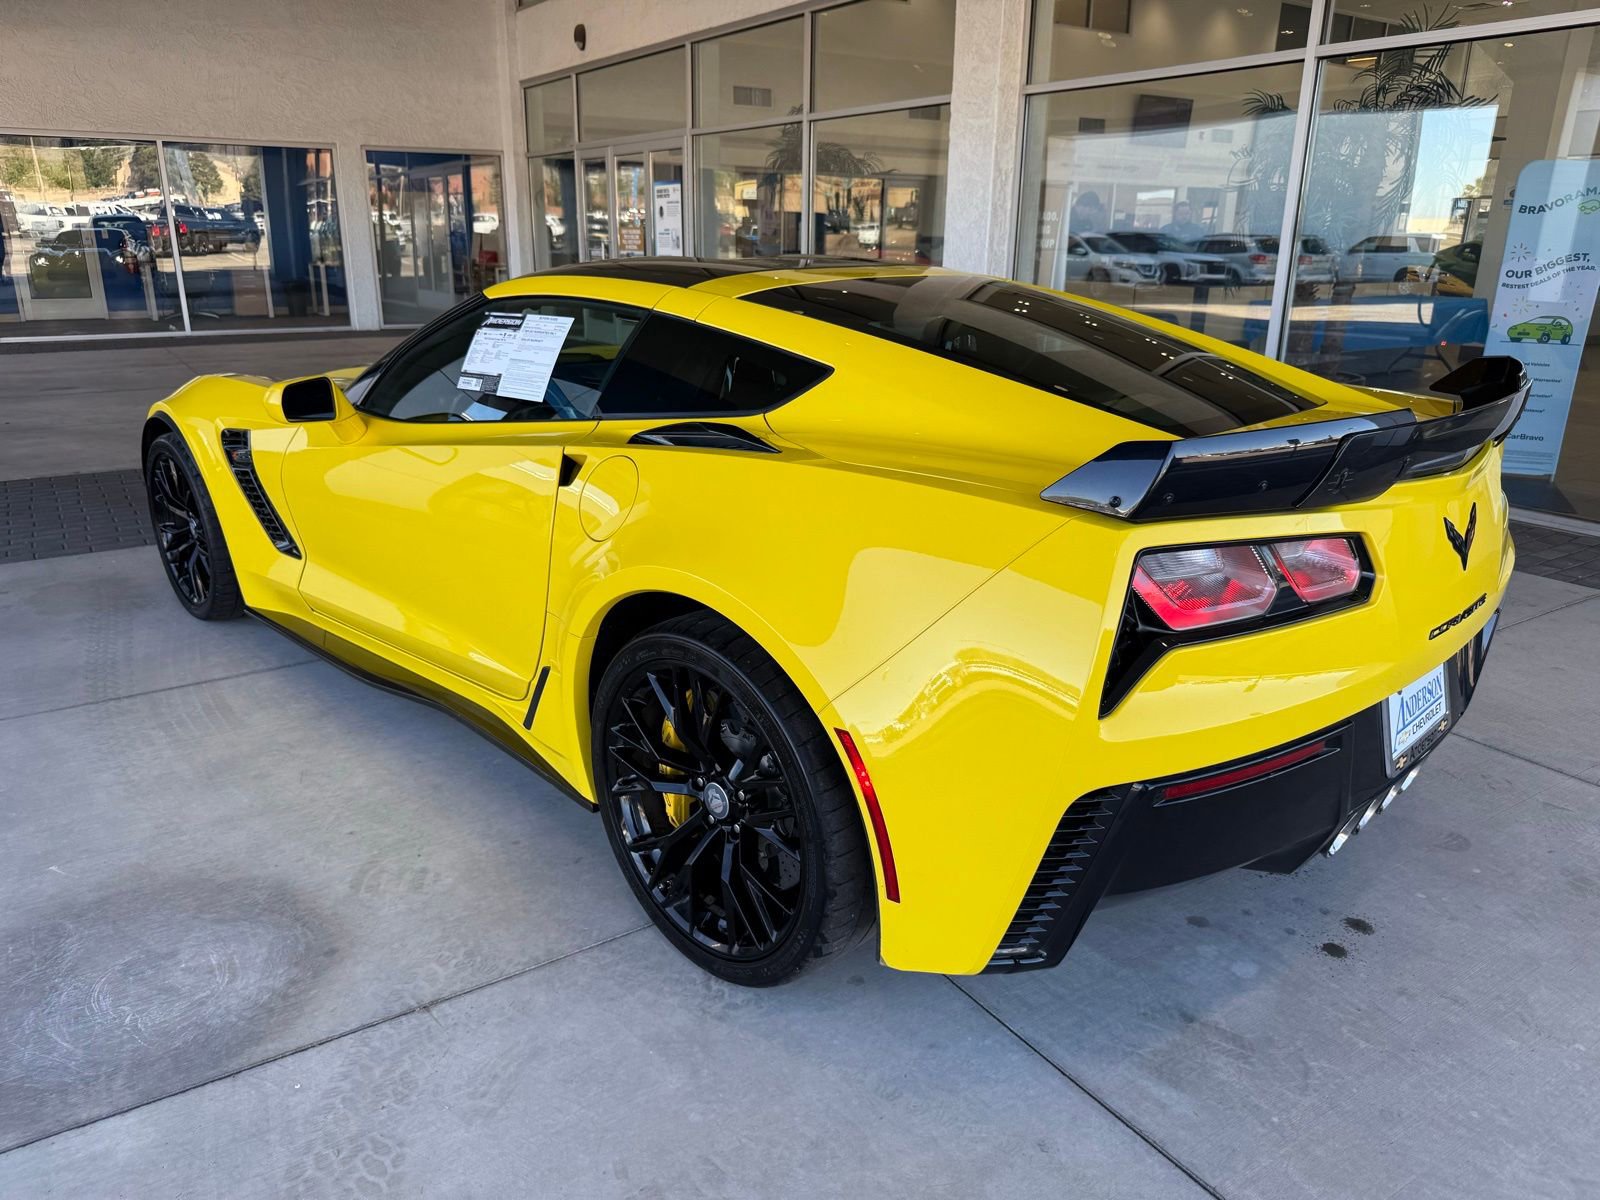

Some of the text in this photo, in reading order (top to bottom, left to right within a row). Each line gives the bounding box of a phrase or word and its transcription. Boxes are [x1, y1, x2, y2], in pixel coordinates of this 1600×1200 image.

[1518, 186, 1600, 215] BRAVORAM
[1505, 252, 1591, 279] OUR BIGGEST,
[1530, 275, 1552, 287] DEALS
[1393, 672, 1443, 752] ANDERSON
[1412, 702, 1442, 735] CHEVROLET
